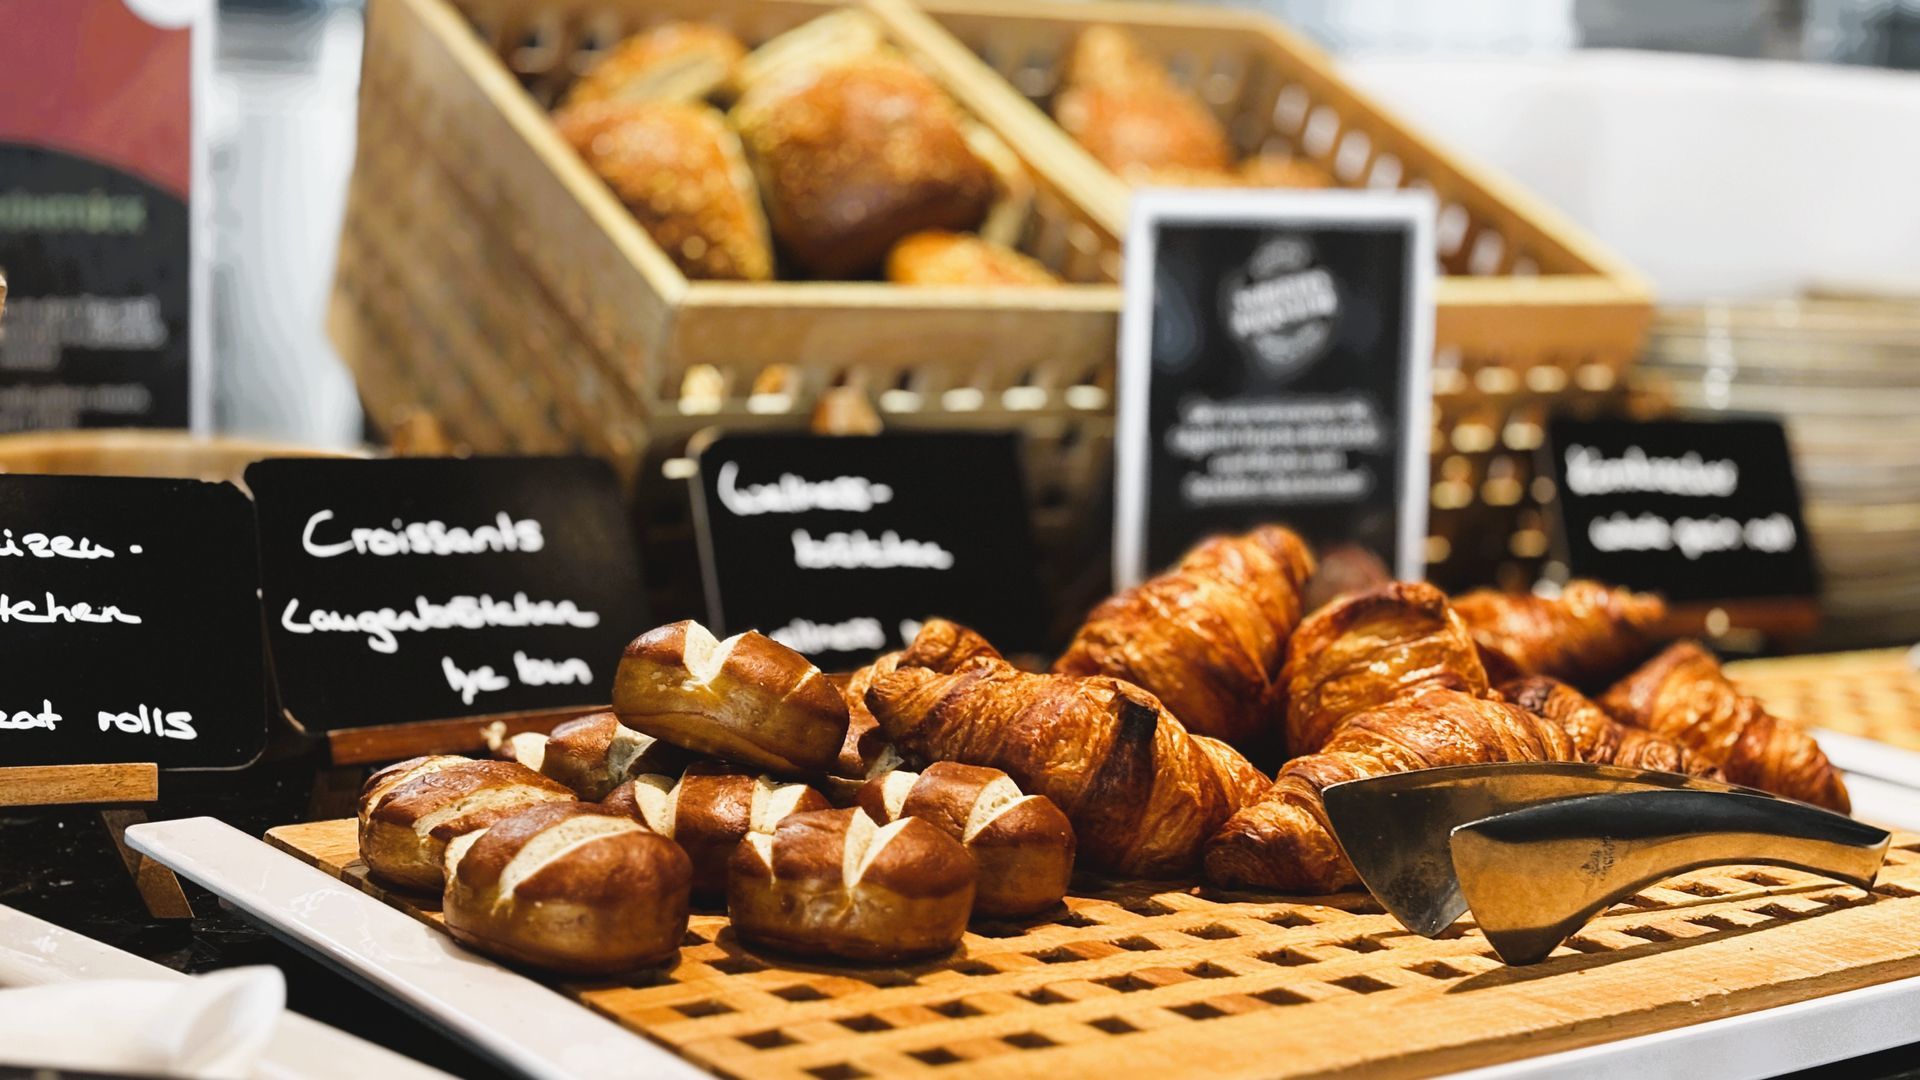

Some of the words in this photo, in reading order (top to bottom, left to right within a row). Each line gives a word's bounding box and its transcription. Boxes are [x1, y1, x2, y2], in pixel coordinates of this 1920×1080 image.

[302, 508, 545, 557] Croissants
[281, 591, 600, 654] Laugenbrötchen
[512, 649, 594, 687] bun
[97, 703, 198, 741] rolls
